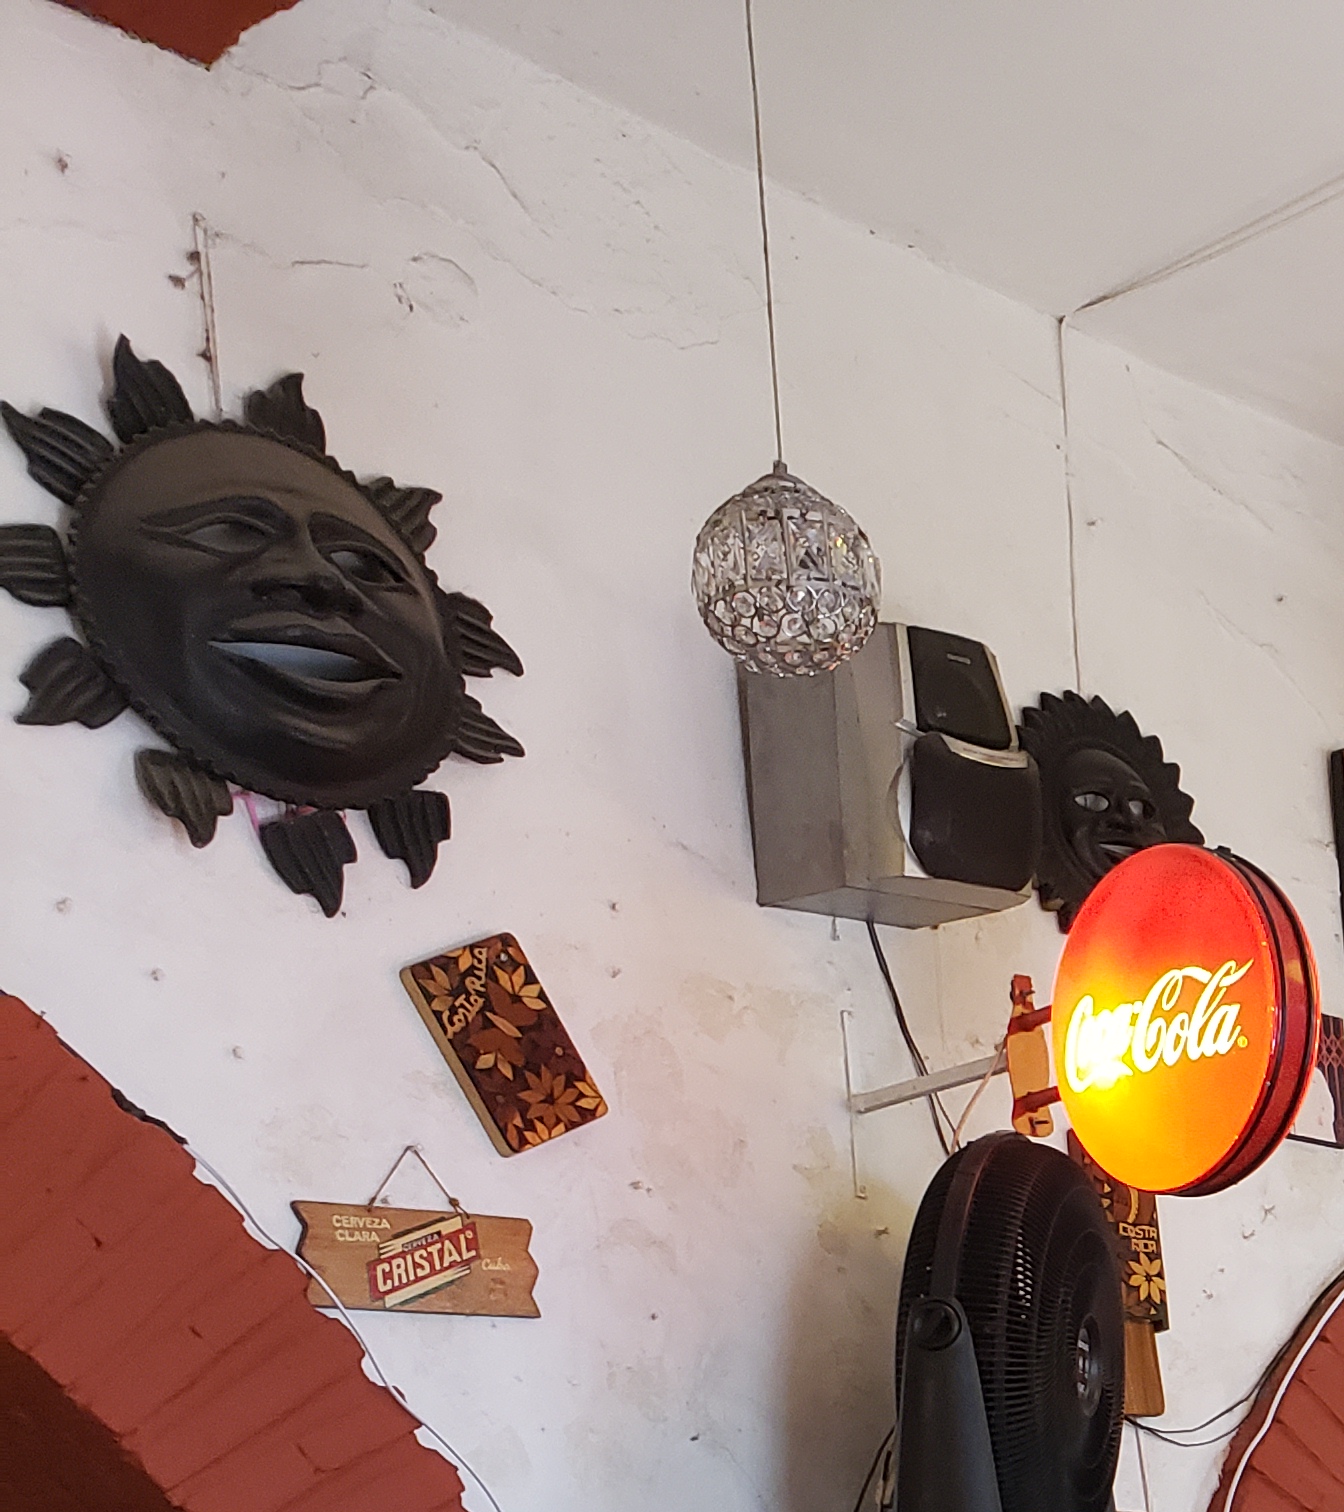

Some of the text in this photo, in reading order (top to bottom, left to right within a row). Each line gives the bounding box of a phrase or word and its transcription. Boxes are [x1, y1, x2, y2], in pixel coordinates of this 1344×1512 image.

[332, 1214, 391, 1230] CERVEZA
[335, 1229, 381, 1242] CLARA
[1119, 1222, 1158, 1240] COSTA
[1131, 1238, 1157, 1254] RICA
[376, 1233, 477, 1293] CRISTAL
